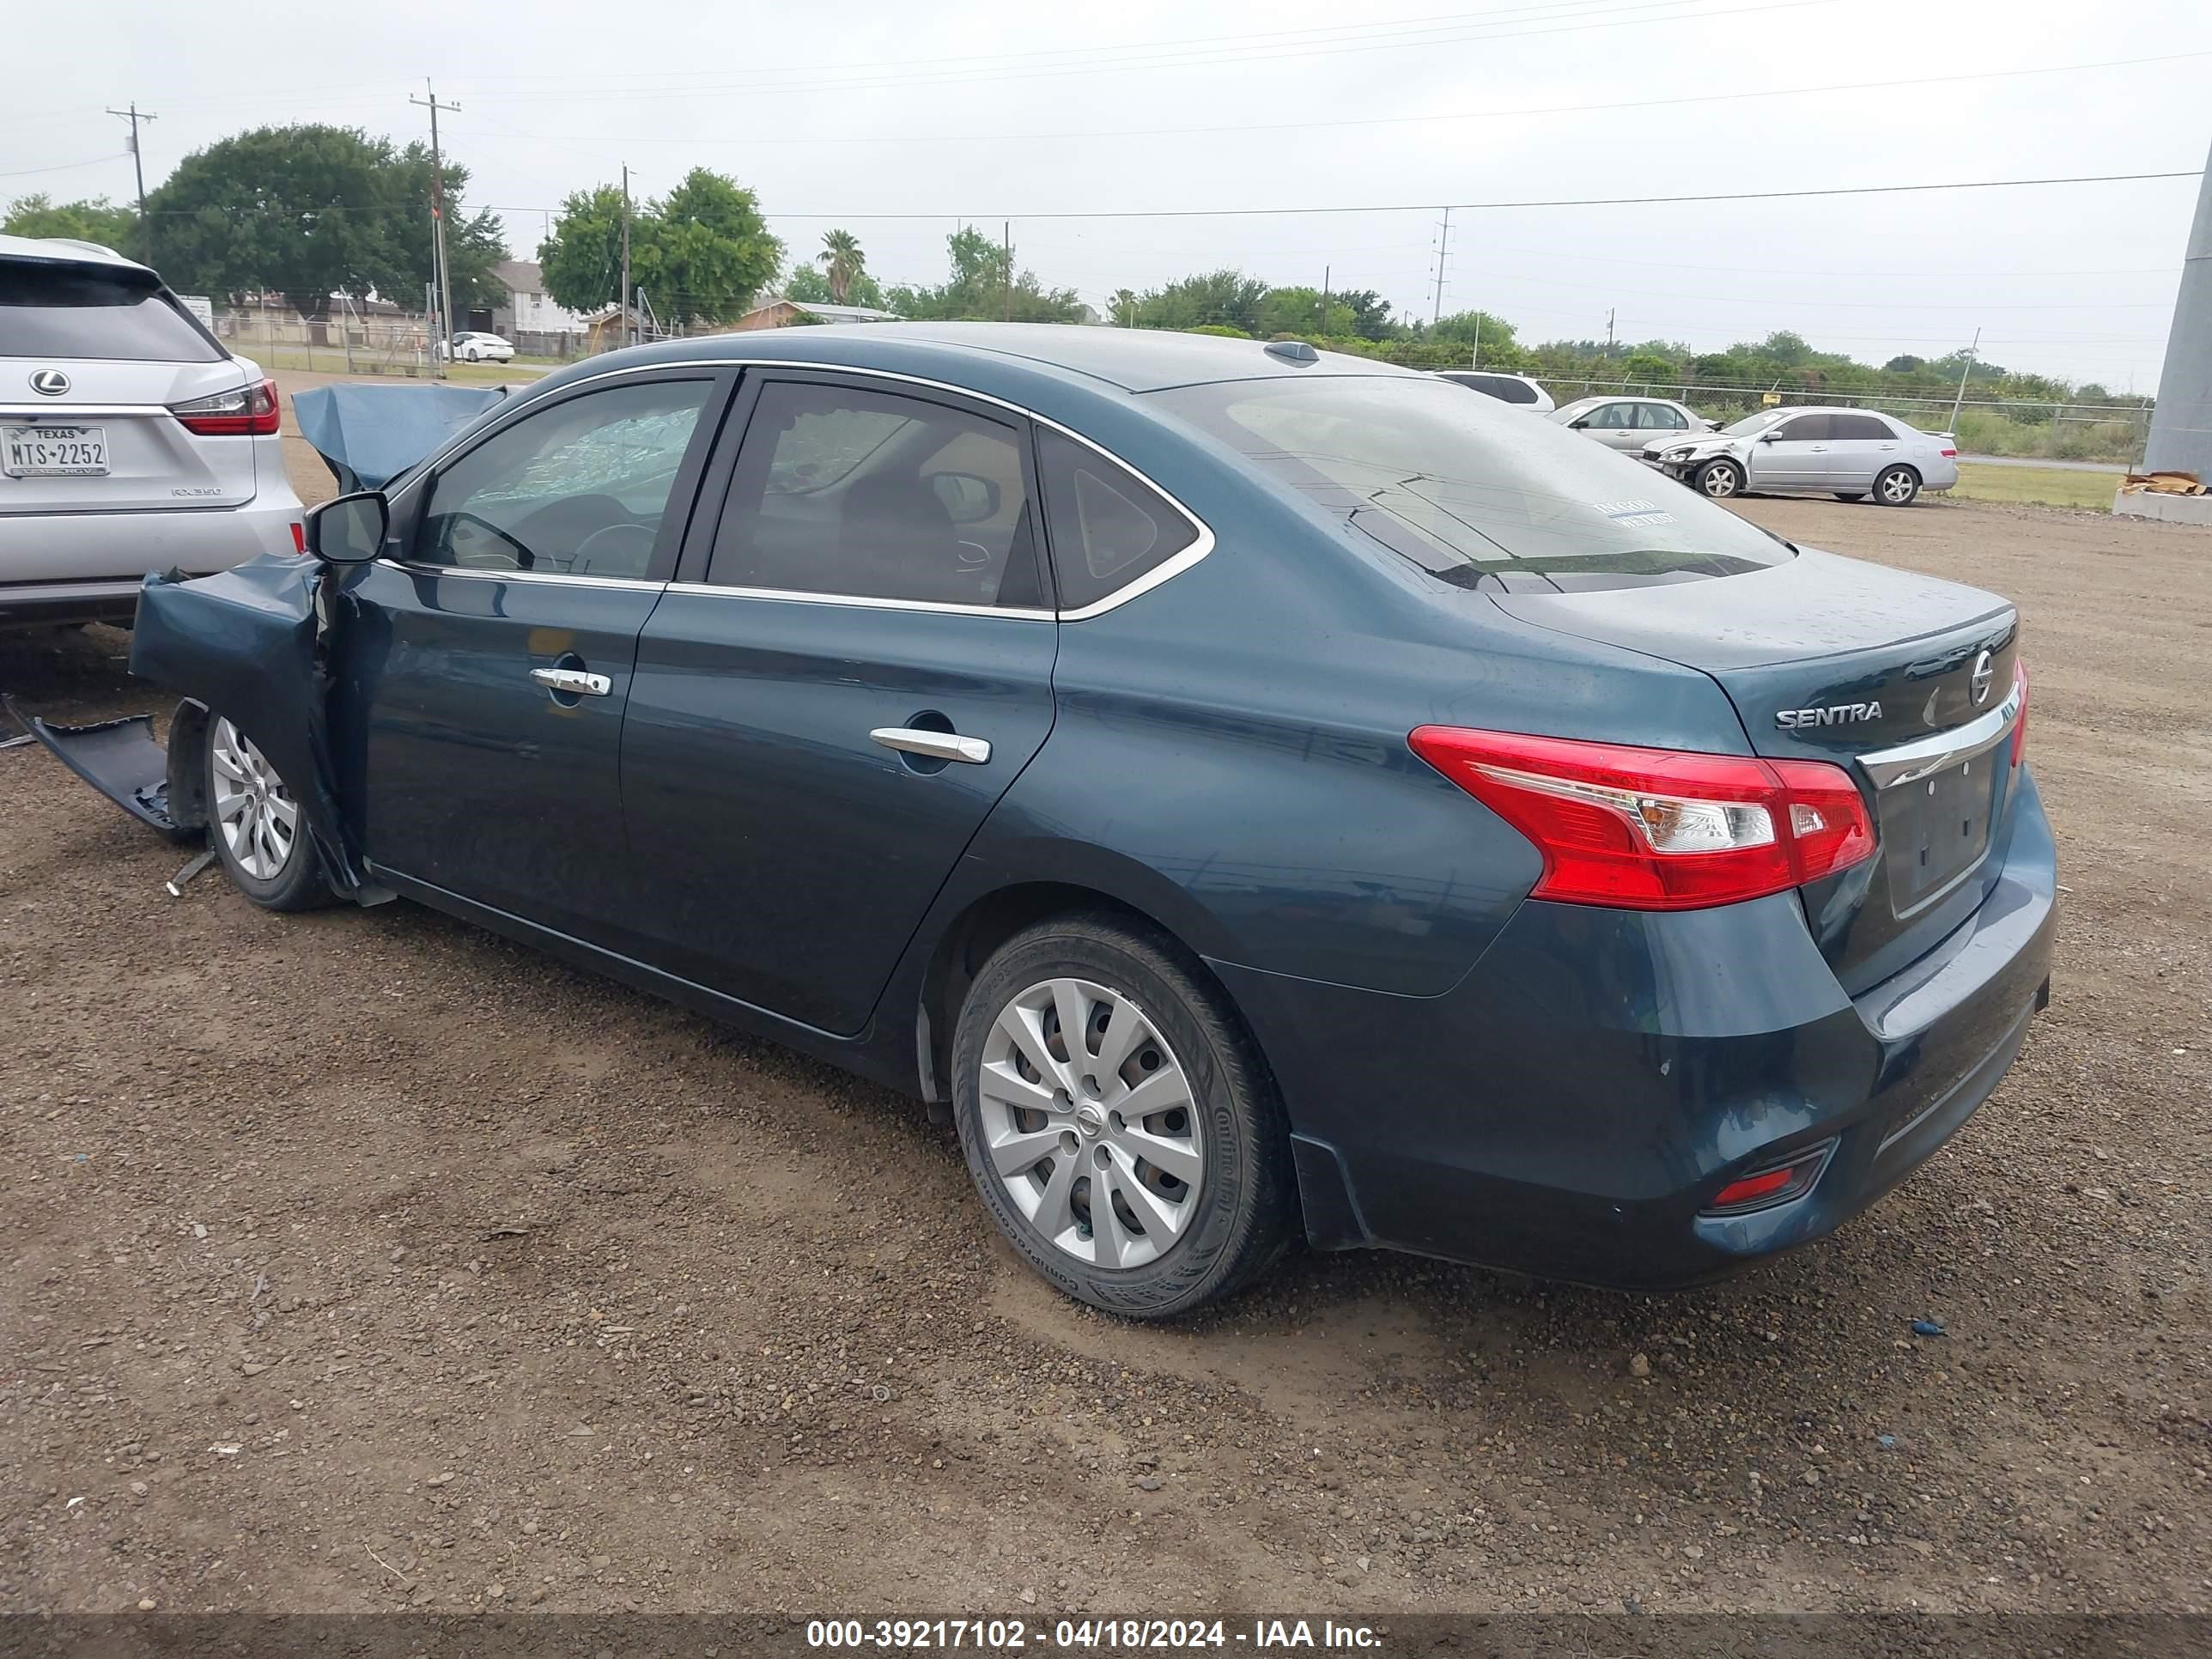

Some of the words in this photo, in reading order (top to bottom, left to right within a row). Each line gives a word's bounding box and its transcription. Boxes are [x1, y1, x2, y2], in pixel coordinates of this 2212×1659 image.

[36, 430, 76, 439] TEXAS
[58, 443, 104, 465] 2252
[1593, 502, 1619, 514] IN
[1616, 500, 1656, 511] GOD
[1612, 516, 1644, 528] WE
[1634, 513, 1678, 525] TRUST
[1775, 700, 1883, 730] SENTRA
